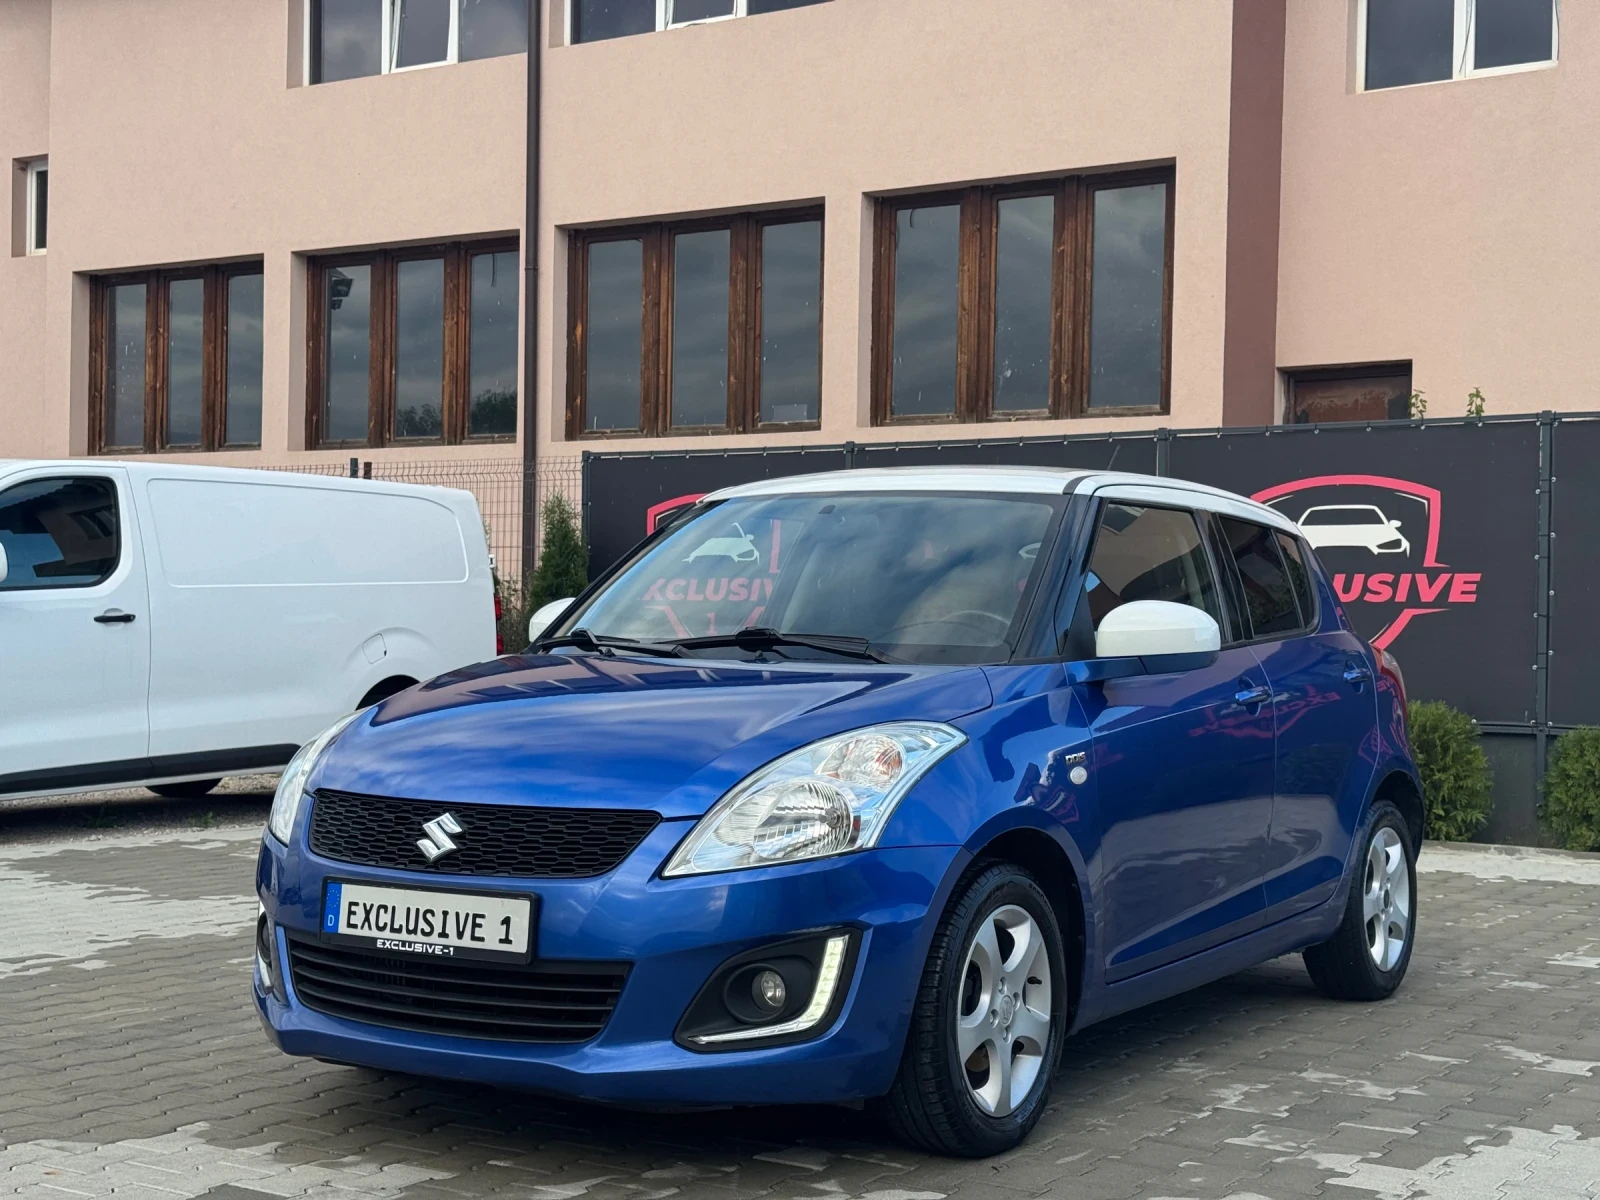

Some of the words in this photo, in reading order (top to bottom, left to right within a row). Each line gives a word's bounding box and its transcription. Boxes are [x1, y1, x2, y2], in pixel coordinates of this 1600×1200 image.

[1332, 573, 1482, 603] USIVE
[327, 914, 335, 927] D
[346, 901, 487, 943] EXCLUSIVE
[498, 915, 513, 945] 1
[376, 939, 454, 956] EXCLUSIVE-1
